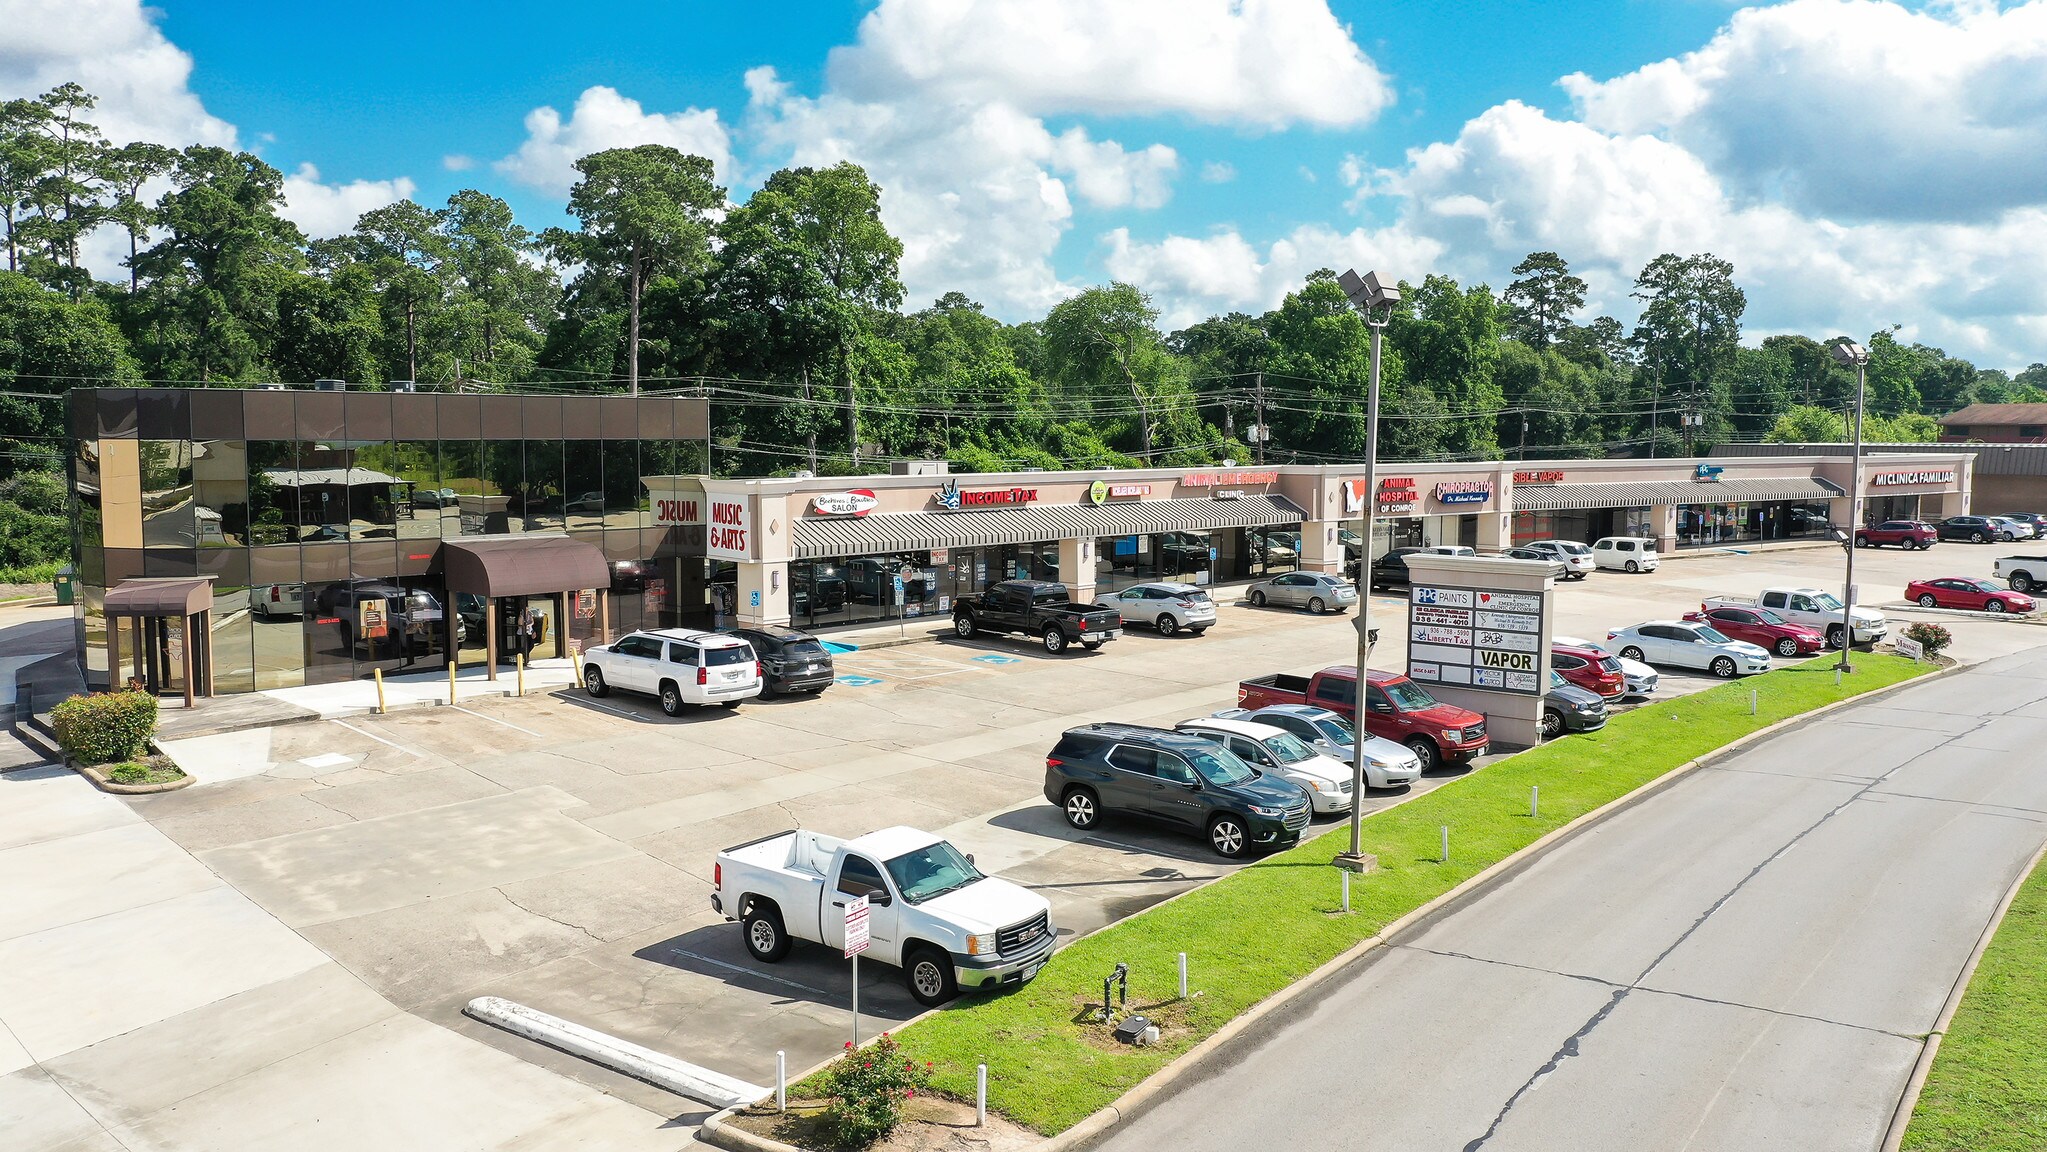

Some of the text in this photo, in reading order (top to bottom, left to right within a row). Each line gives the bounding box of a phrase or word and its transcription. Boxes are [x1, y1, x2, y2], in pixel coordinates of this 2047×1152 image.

[1182, 472, 1278, 486] ANIMAL EMERGENCY
[1383, 478, 1416, 488] ANIMAL
[1538, 471, 1564, 482] VAPOR
[1876, 472, 1954, 486] MI CLINICA FAMILIAR
[961, 488, 1038, 506] INCOME TAX
[1218, 490, 1244, 498] CLINIC
[1380, 491, 1420, 502] HOSPITAL
[1436, 481, 1494, 500] CHIROPRACTOR
[712, 502, 742, 526] MUSIC
[1381, 504, 1416, 513] OF CONROE
[710, 527, 745, 551] & ARTS
[1418, 588, 1468, 604] PPG PAINTS
[1427, 634, 1452, 643] LIBERTY
[1480, 651, 1532, 670] VAPOR
